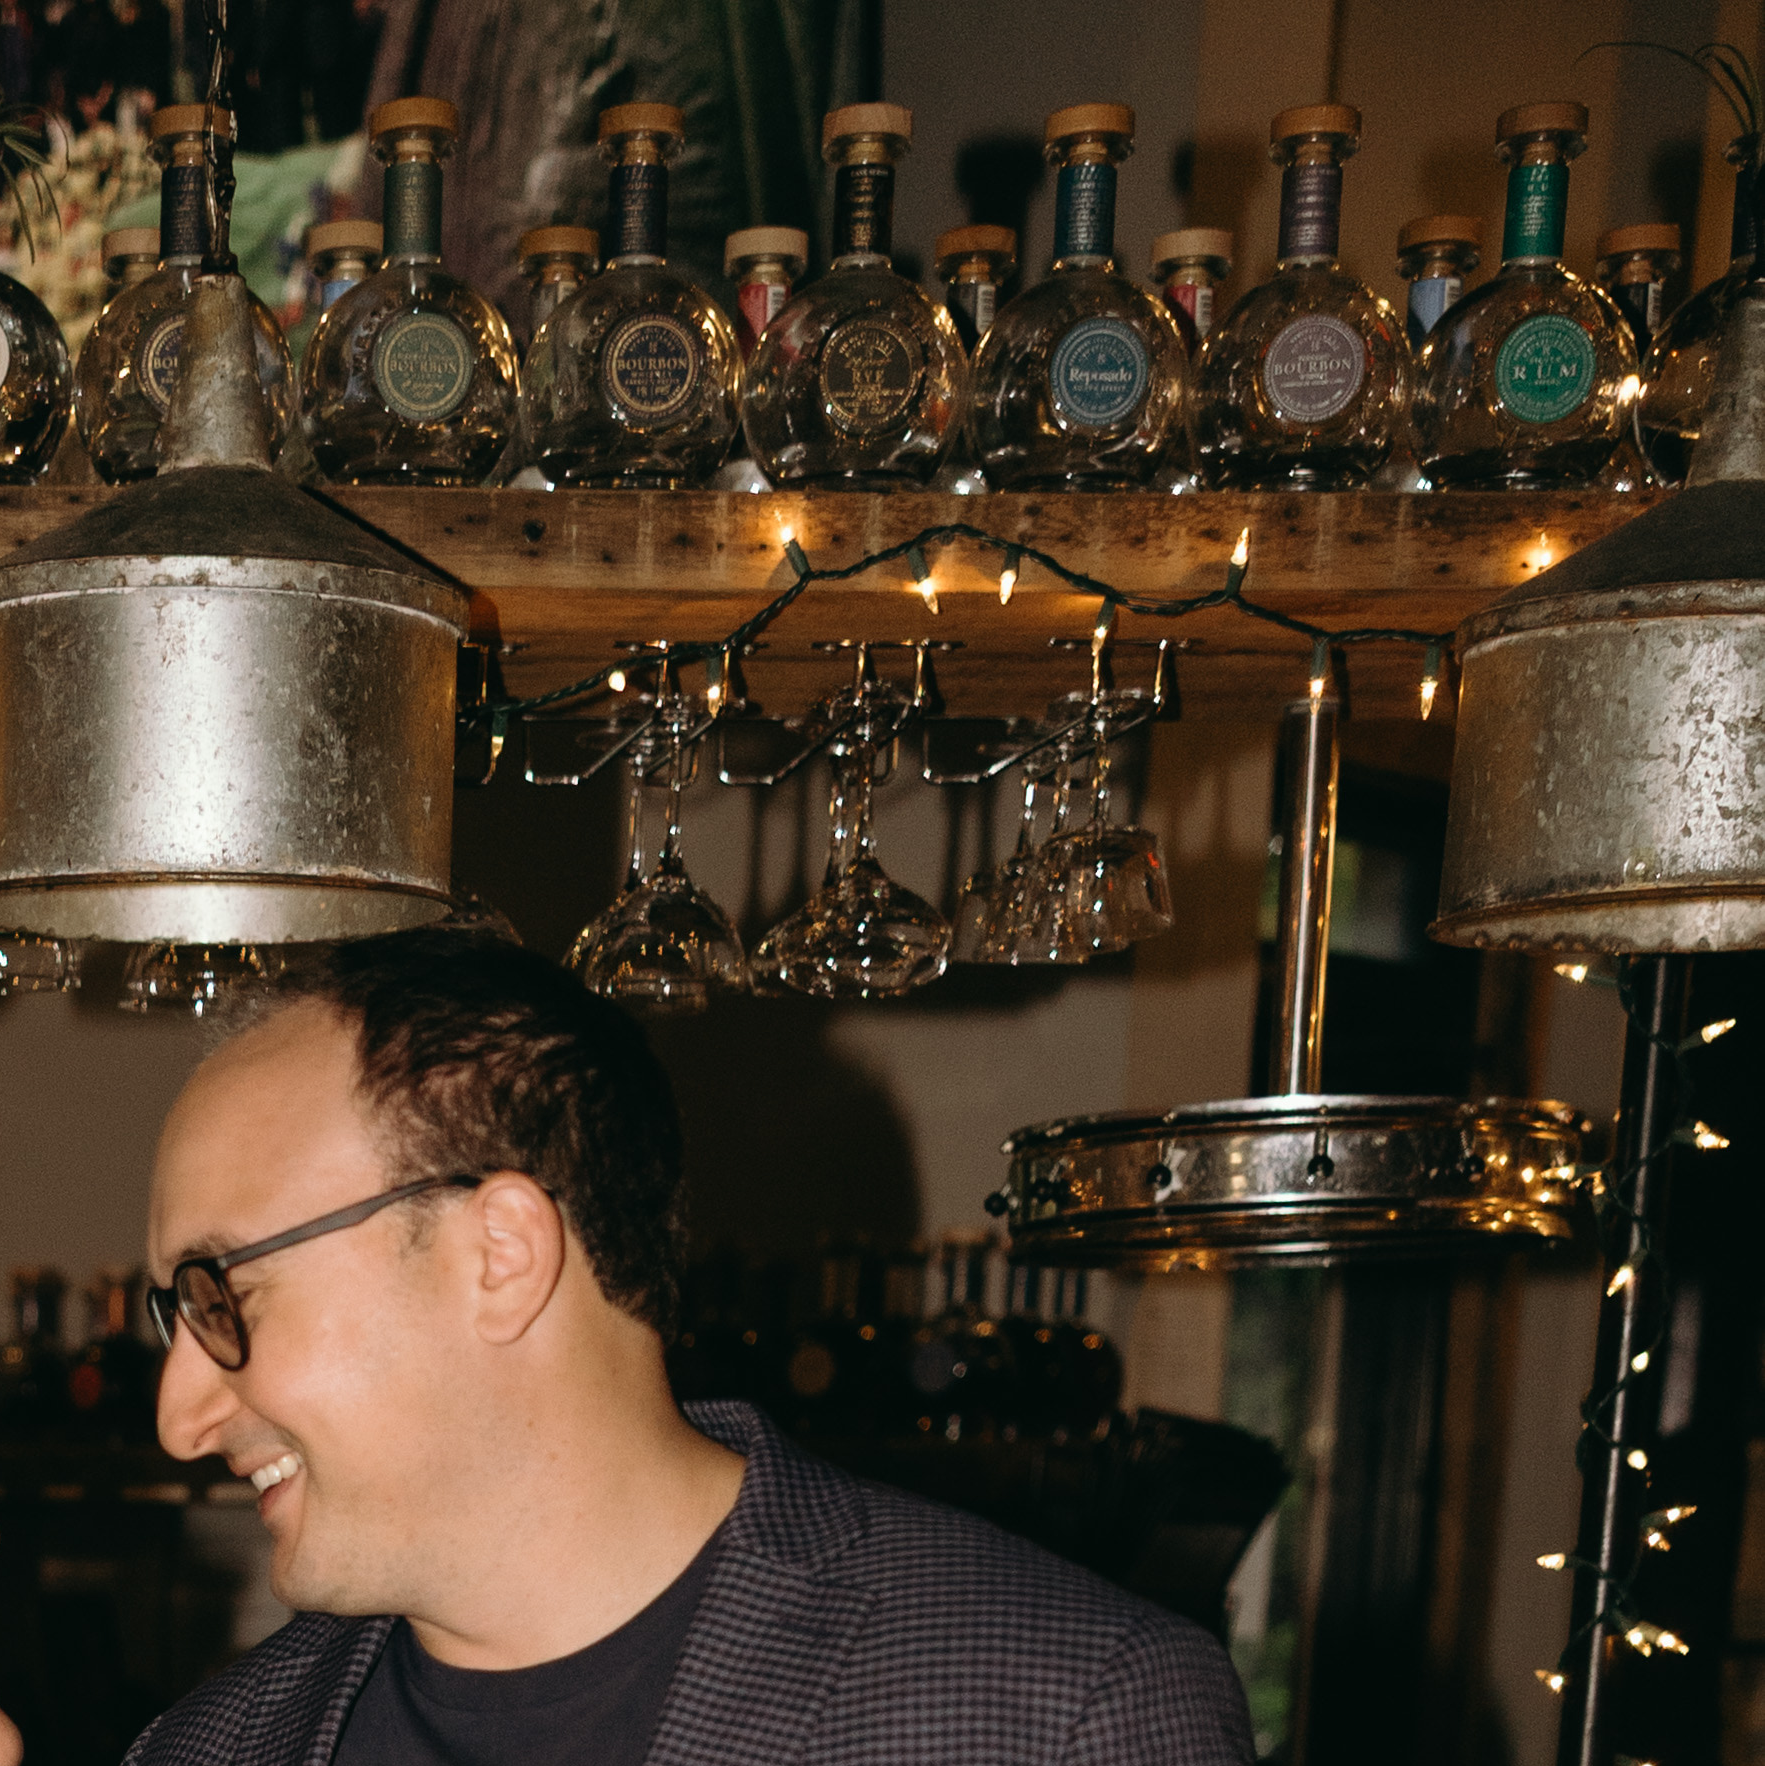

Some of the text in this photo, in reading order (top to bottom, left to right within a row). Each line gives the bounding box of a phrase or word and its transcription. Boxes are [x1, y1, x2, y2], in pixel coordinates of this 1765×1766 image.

[389, 360, 457, 374] BOURBON
[617, 357, 688, 372] BOURBON
[1275, 358, 1352, 376] BOURBON
[1513, 363, 1577, 380] RUM
[852, 368, 884, 382] RYE
[1069, 366, 1133, 386] Reposado
